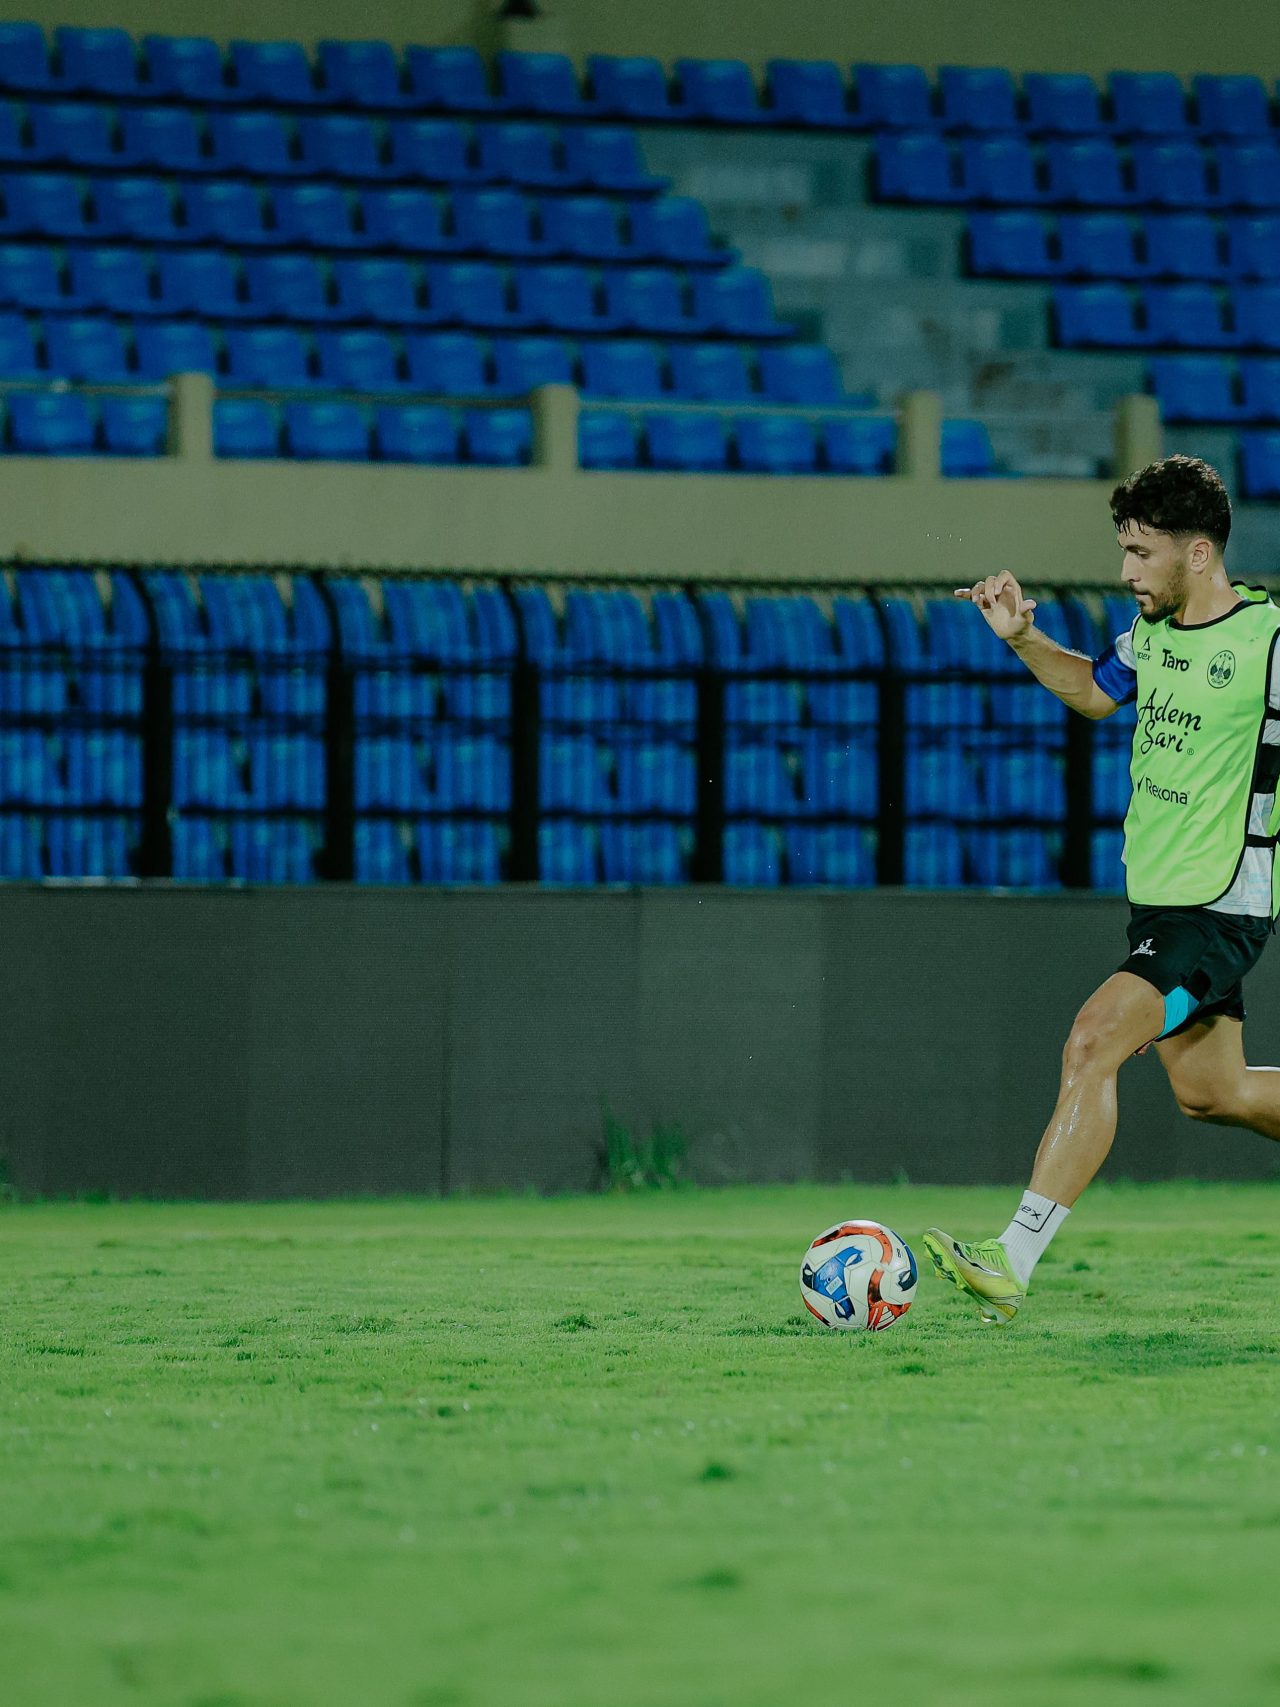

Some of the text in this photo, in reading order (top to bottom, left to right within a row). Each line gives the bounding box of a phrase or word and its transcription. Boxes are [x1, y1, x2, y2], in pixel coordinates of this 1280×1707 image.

[1161, 648, 1190, 672] Taro
[1138, 687, 1202, 731] Adem
[1140, 719, 1188, 755] Sari
[1145, 776, 1188, 805] Rexona
